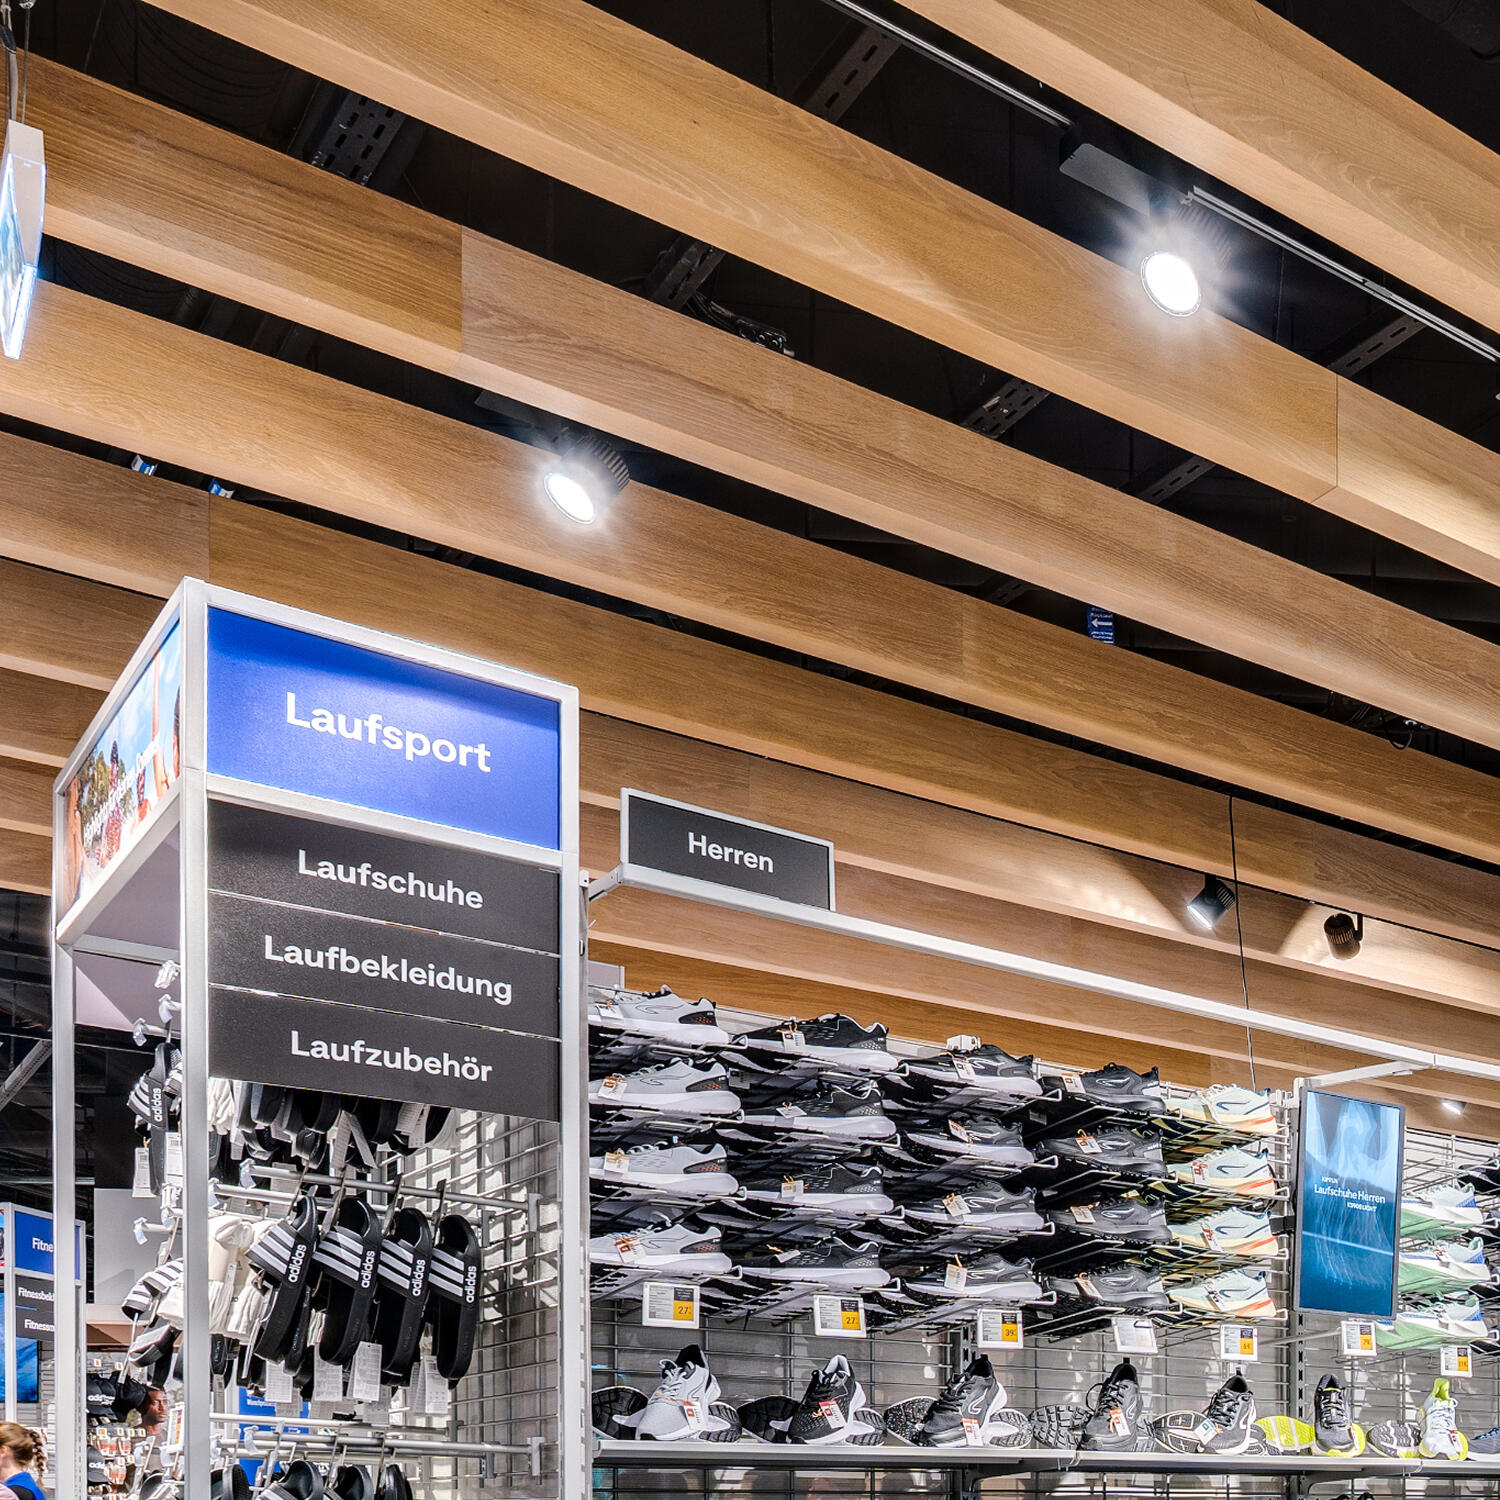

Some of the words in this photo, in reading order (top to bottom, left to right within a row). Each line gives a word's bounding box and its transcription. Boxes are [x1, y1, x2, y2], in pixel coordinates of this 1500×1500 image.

[286, 691, 491, 773] Laufsport
[688, 832, 774, 873] Herren
[298, 850, 484, 910] Laufschuhe
[264, 935, 513, 1006] Laufbekleidung
[291, 1031, 493, 1082] Laufzubehör
[152, 1086, 163, 1123] adidas
[1314, 1184, 1357, 1200] Laufschuhe
[1357, 1190, 1386, 1204] Herren
[287, 1243, 308, 1284] adidas
[360, 1249, 376, 1289] adidas
[411, 1258, 426, 1298] adidas
[465, 1264, 477, 1304] adidas
